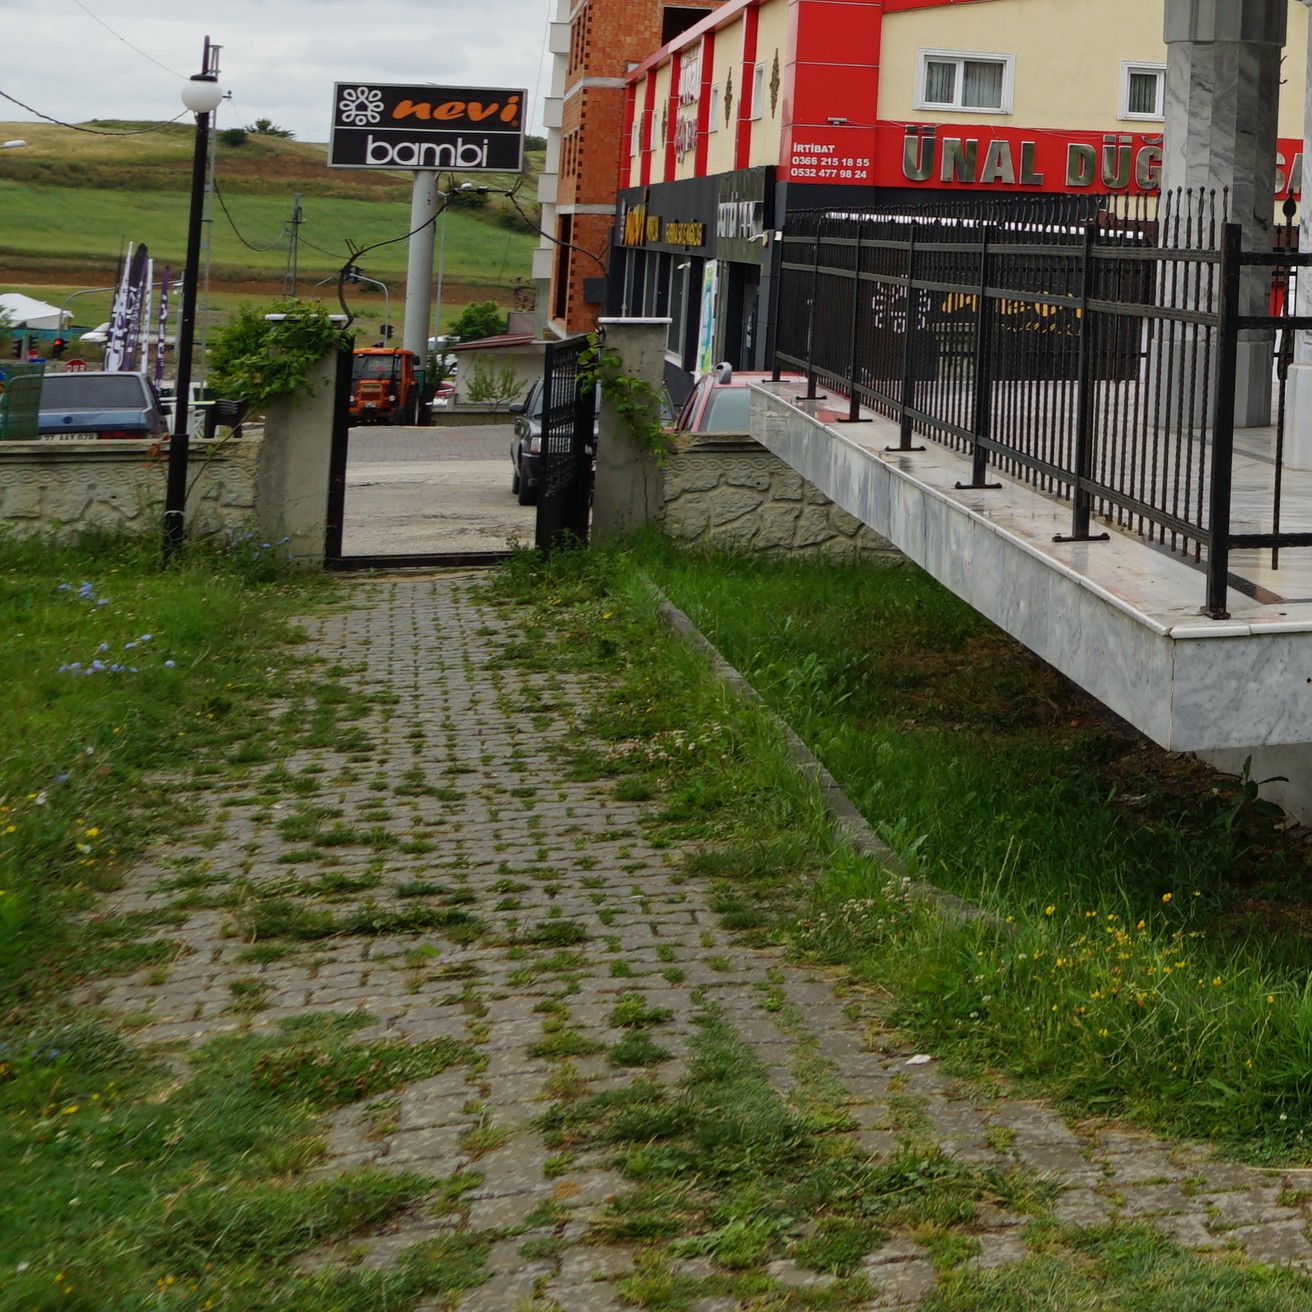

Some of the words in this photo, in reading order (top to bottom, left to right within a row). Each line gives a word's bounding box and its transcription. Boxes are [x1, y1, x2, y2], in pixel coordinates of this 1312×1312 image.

[392, 95, 520, 122] nevi
[365, 135, 489, 168] bambi
[793, 142, 835, 154] İRTİBAT
[902, 124, 1044, 186] ÜNAL
[1065, 134, 1164, 190] DÜĞ
[791, 156, 818, 165] 0366
[820, 157, 839, 166] 215
[841, 158, 854, 167] 18
[856, 158, 870, 167] 55
[790, 168, 816, 177] 0532
[818, 169, 838, 178] 477
[840, 170, 852, 178] 98
[854, 170, 867, 179] 24
